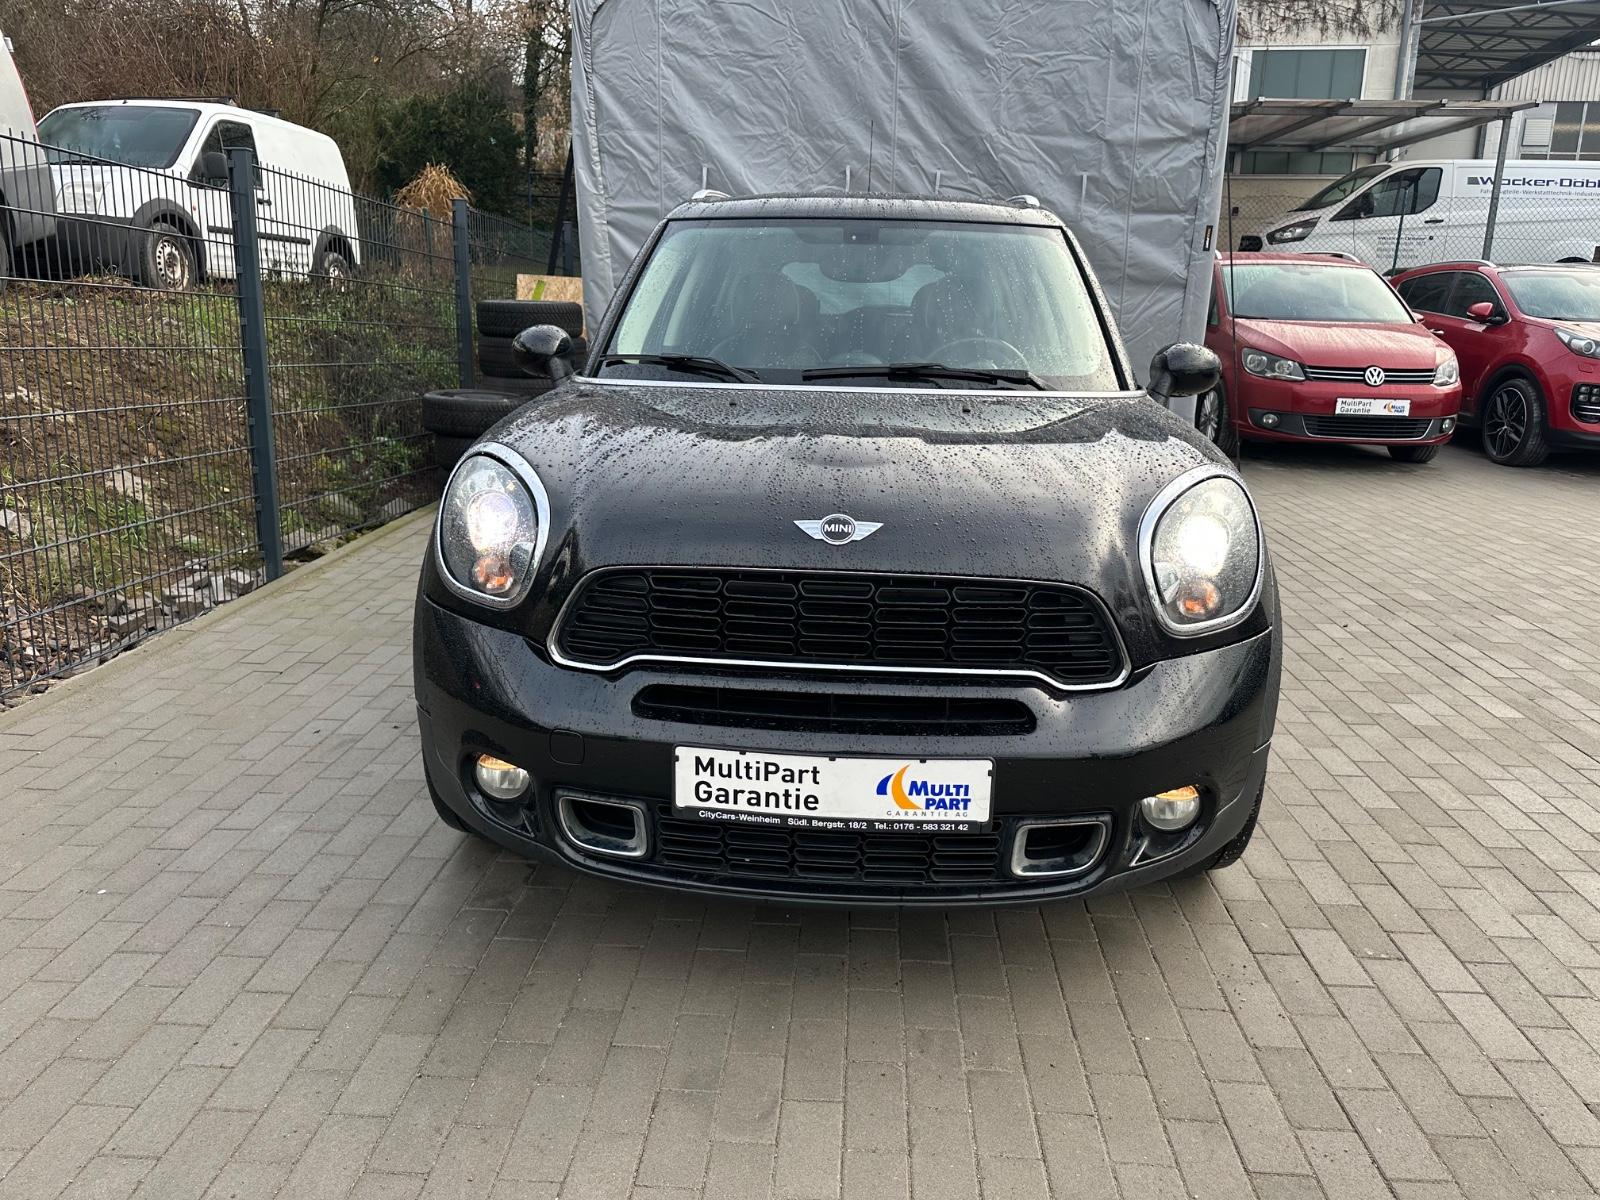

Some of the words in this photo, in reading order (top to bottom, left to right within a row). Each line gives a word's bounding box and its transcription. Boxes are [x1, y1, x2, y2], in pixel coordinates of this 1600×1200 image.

[824, 523, 852, 533] MINI
[694, 755, 820, 785] MultiPart
[694, 780, 819, 811] Garantie
[908, 780, 970, 796] MULTI
[925, 798, 971, 810] PART
[698, 810, 781, 824] CityCars-Weinheim
[787, 817, 810, 827] Südl.
[811, 819, 846, 829] Bergstr.
[848, 821, 867, 829] 18/2
[873, 822, 892, 830] Tel.:
[893, 822, 914, 830] 0176
[922, 823, 938, 831] 583
[940, 823, 955, 831] 321
